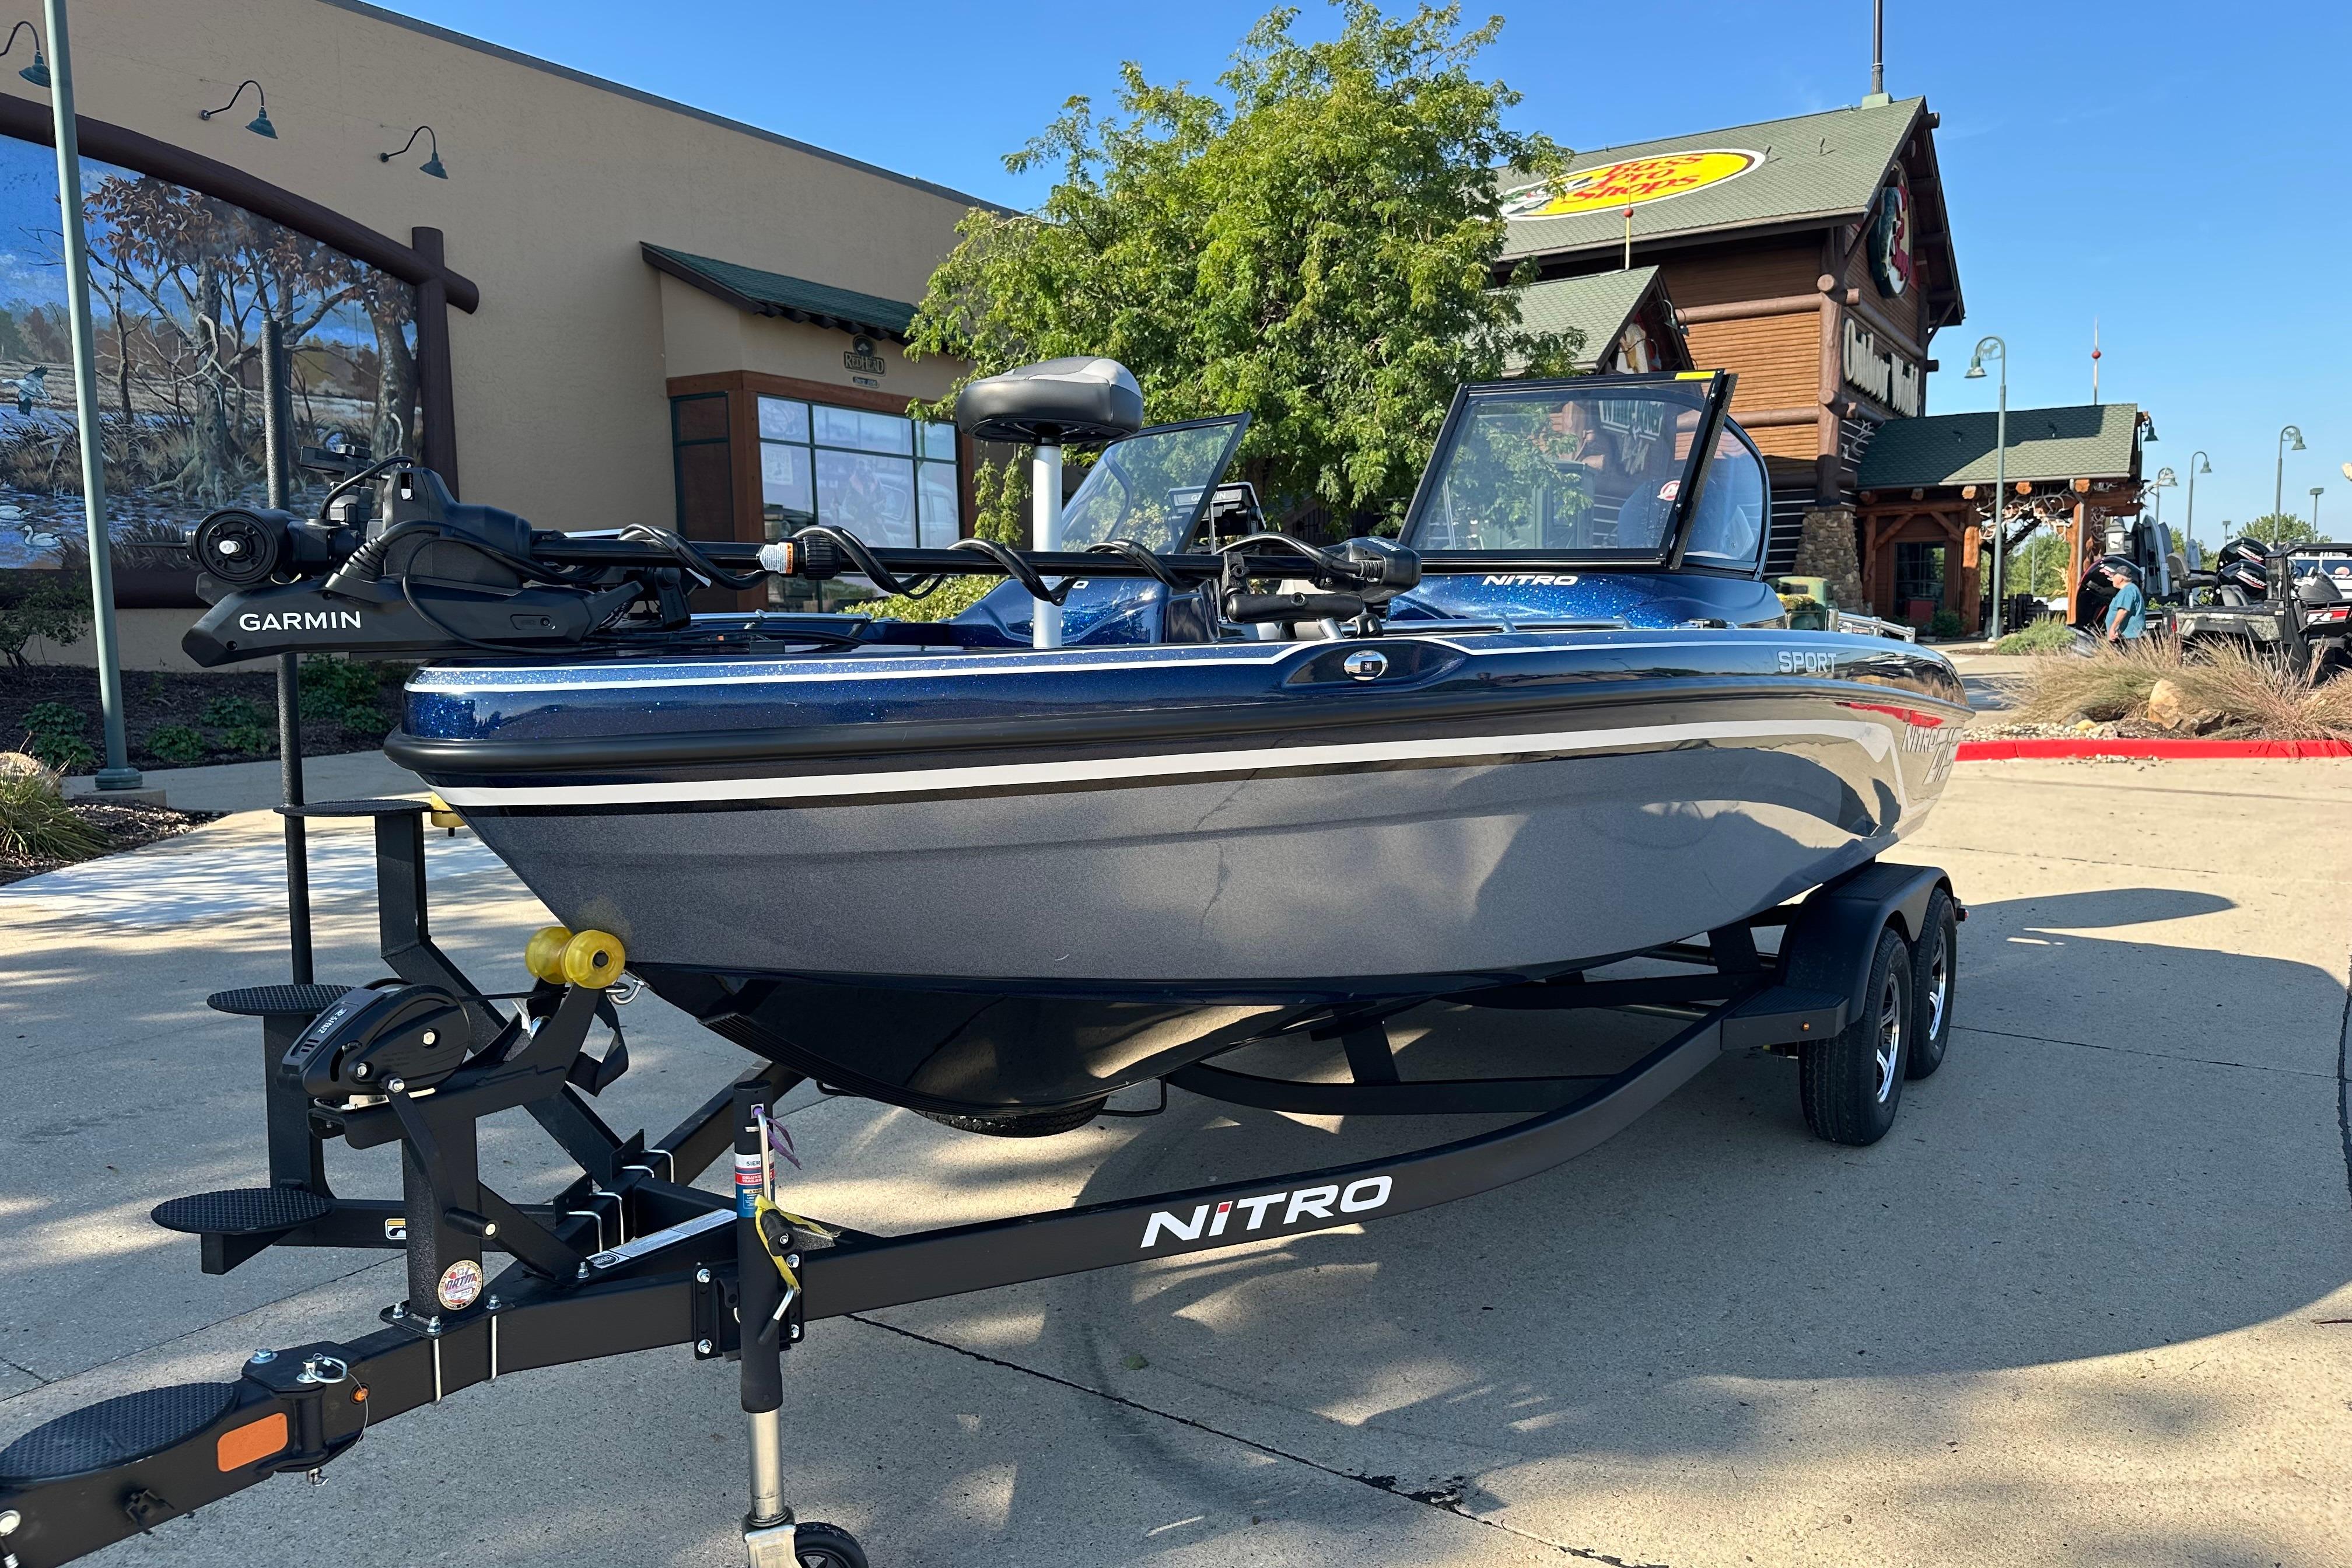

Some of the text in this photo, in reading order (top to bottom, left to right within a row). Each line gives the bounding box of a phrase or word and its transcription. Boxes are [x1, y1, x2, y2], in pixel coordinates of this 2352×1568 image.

[1598, 154, 1703, 177] Bass
[1562, 175, 1700, 204] Shops
[1591, 169, 1675, 190] Pro
[1843, 318, 1891, 404] Outdoor
[1367, 538, 1401, 551] GARMIN
[1482, 575, 1578, 586] NITRO
[2236, 570, 2267, 586] MERCURY
[239, 611, 362, 631] GARMIN
[1777, 650, 1837, 673] SPORT
[1140, 1175, 1393, 1248] NITRO
